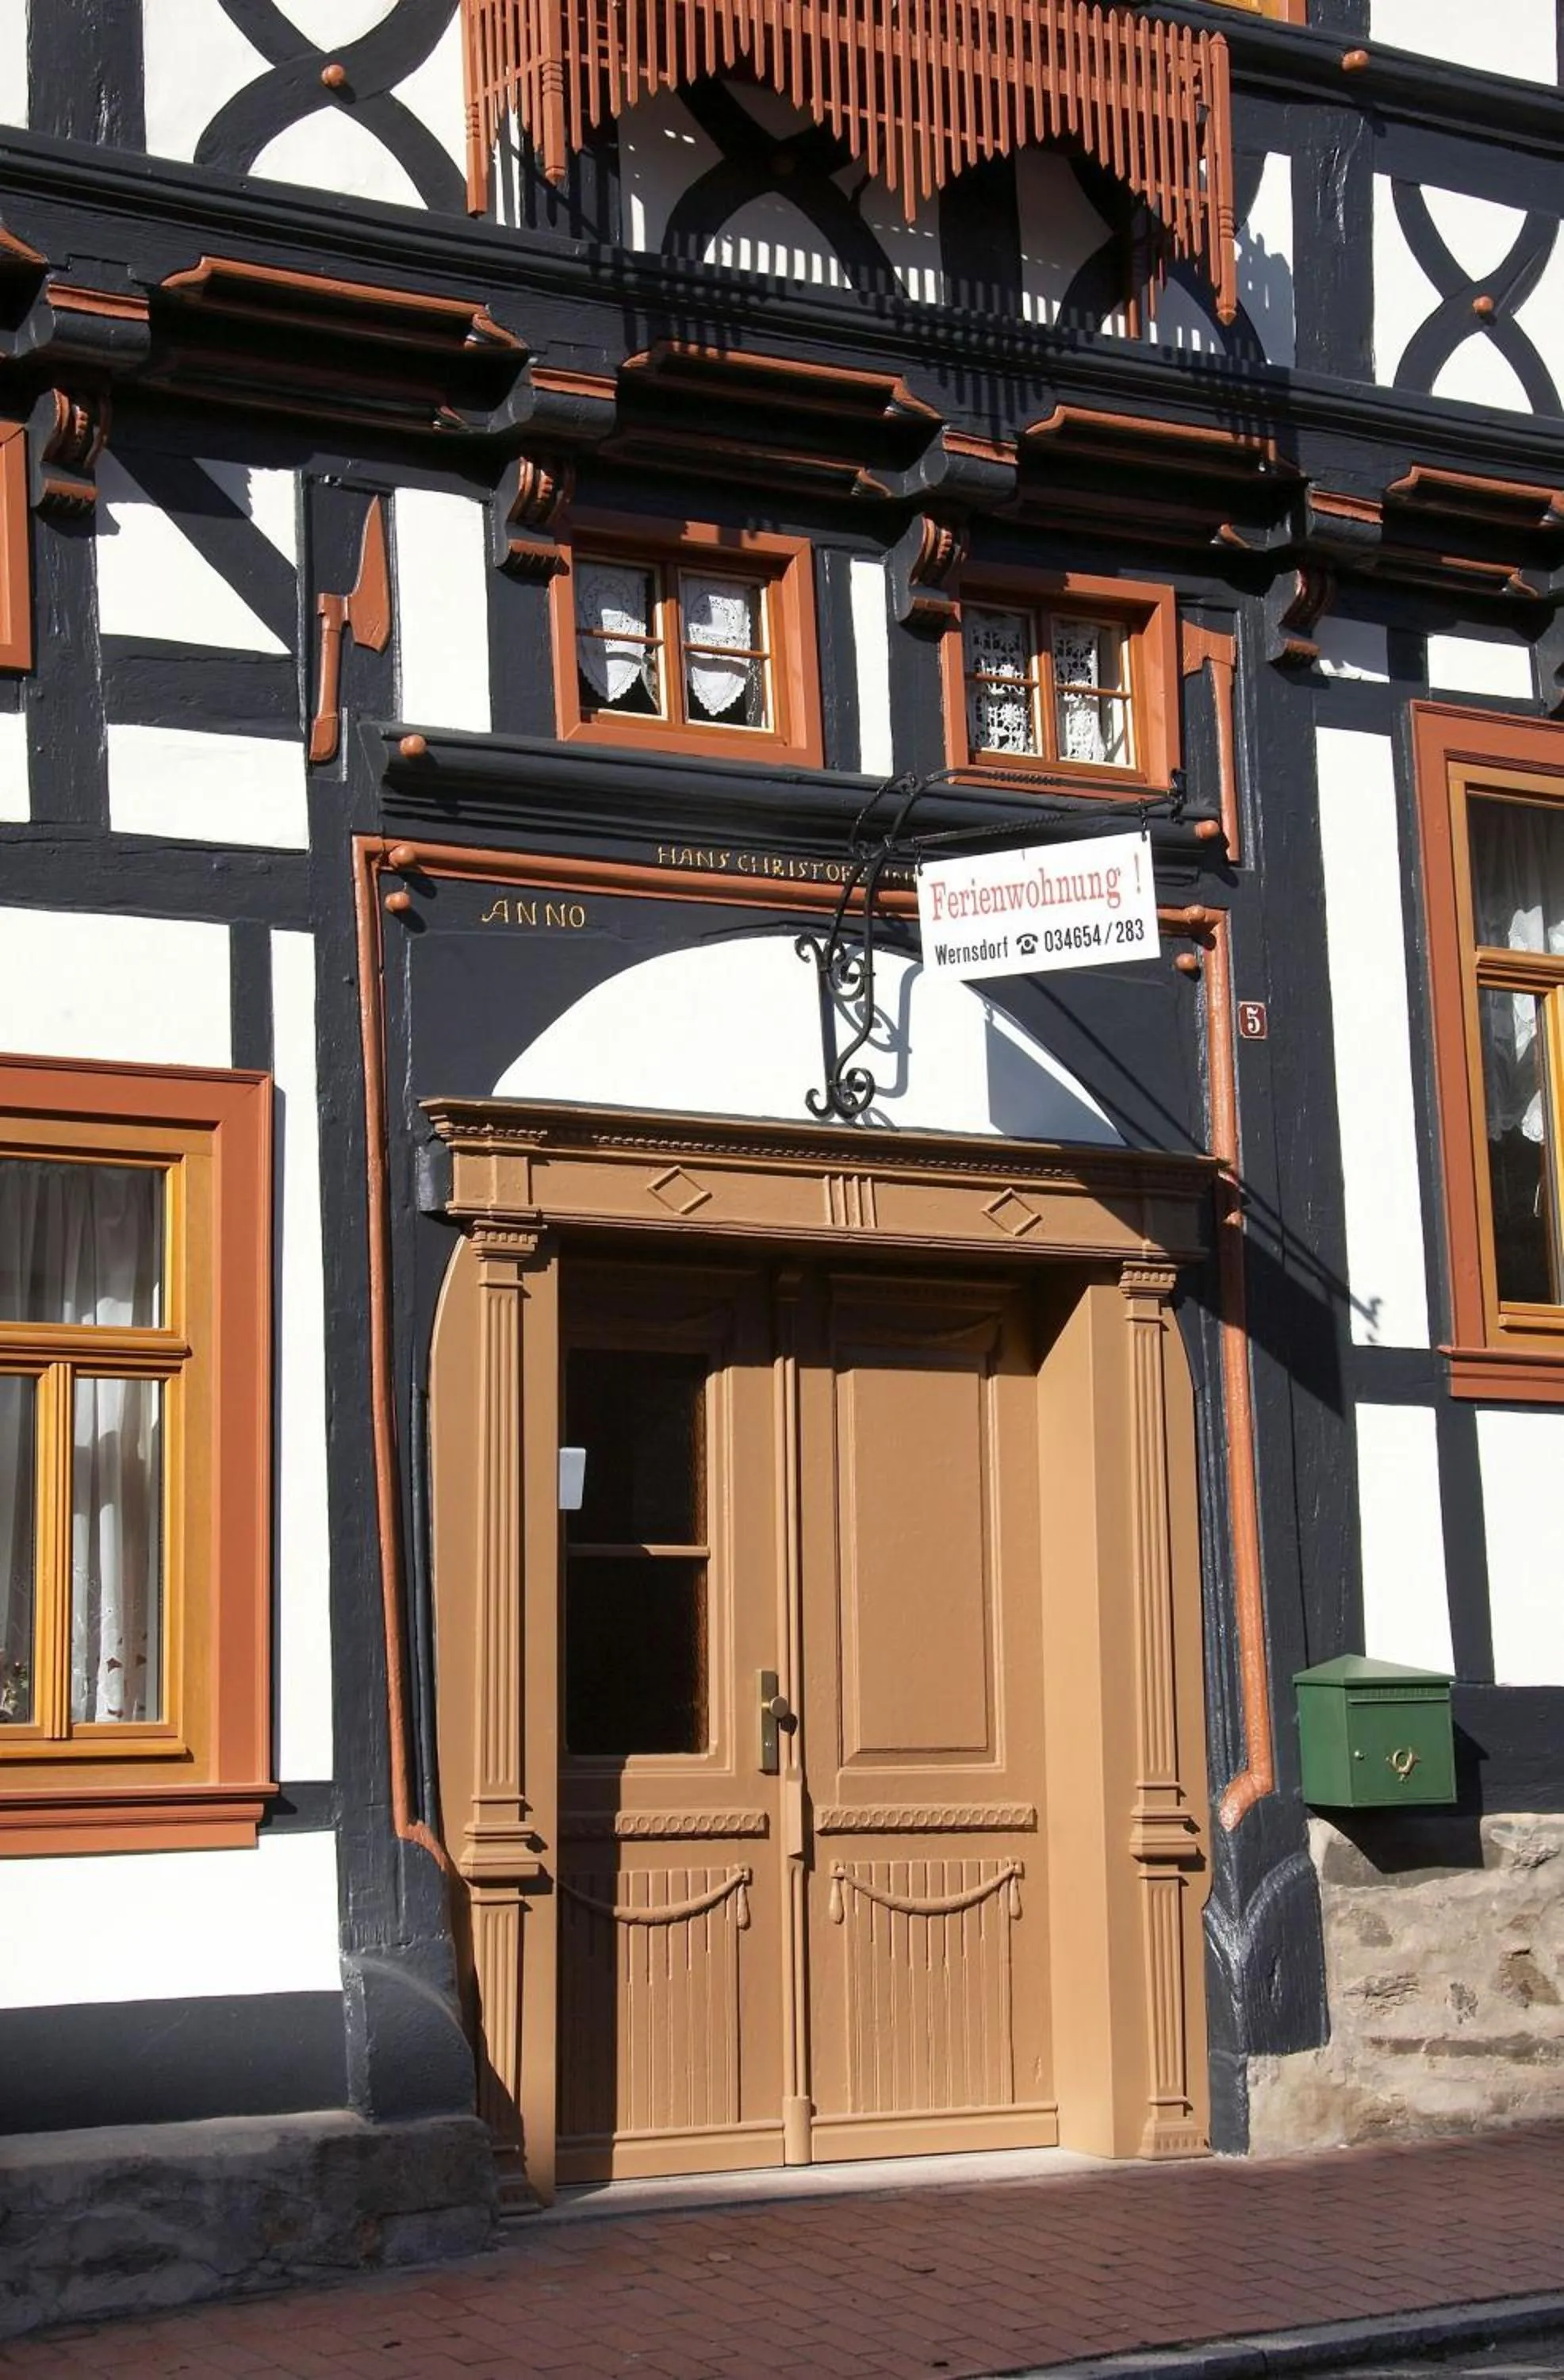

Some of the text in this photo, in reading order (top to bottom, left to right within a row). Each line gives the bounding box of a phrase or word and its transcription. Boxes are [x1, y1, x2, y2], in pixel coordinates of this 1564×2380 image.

[657, 846, 730, 869] HANS
[930, 867, 1121, 921] Ferienwohnung
[481, 899, 585, 927] ANNO
[935, 936, 1008, 965] Wernsdorf
[1246, 1006, 1261, 1034] 5
